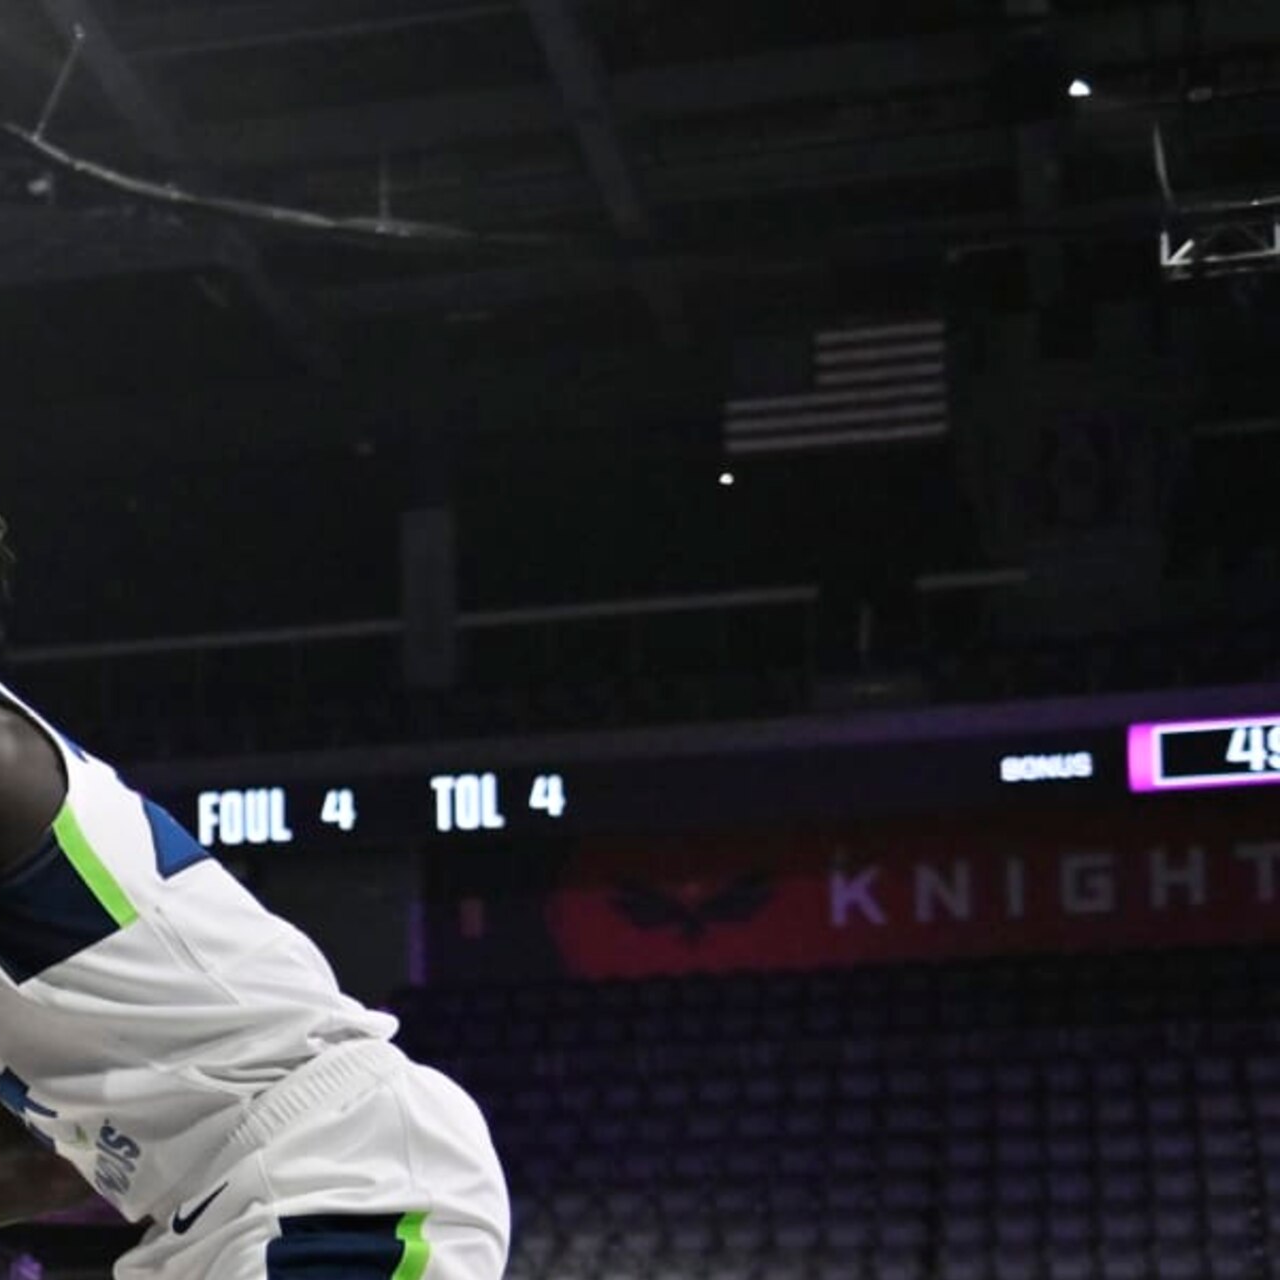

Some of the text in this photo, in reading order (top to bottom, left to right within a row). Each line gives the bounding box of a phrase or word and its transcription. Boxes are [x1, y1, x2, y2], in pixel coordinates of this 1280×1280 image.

[1000, 752, 1093, 782] BONUS
[198, 787, 356, 847] FOUL 4
[430, 772, 566, 832] TOL 4
